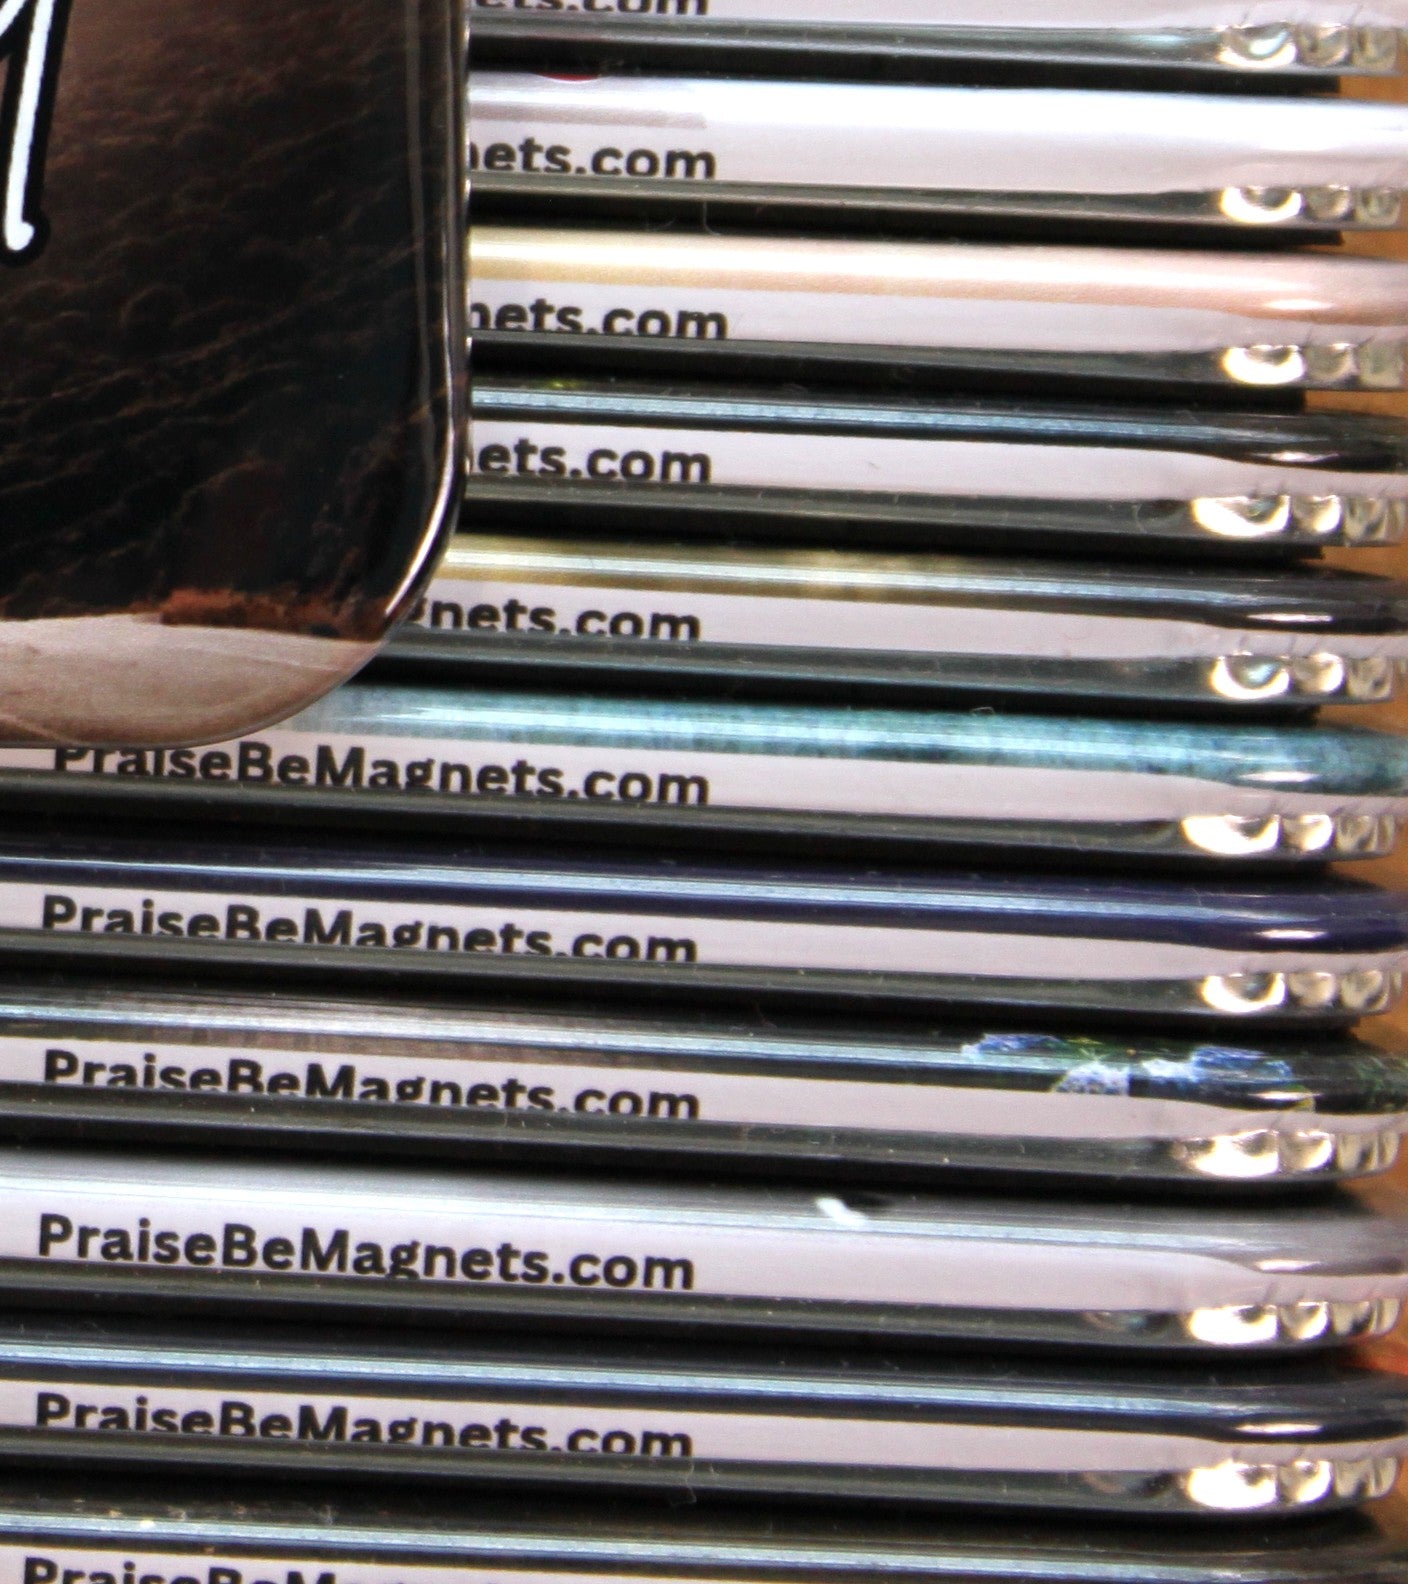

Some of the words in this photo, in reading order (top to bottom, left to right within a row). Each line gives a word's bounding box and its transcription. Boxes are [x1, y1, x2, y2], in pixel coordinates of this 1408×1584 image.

[469, 133, 716, 181] ets.com
[467, 439, 712, 485] ets.com
[410, 594, 701, 642] nets.com
[38, 1214, 695, 1289] PraiseBeMagnets.com
[35, 1392, 693, 1458] PraiseBeMagnets.com
